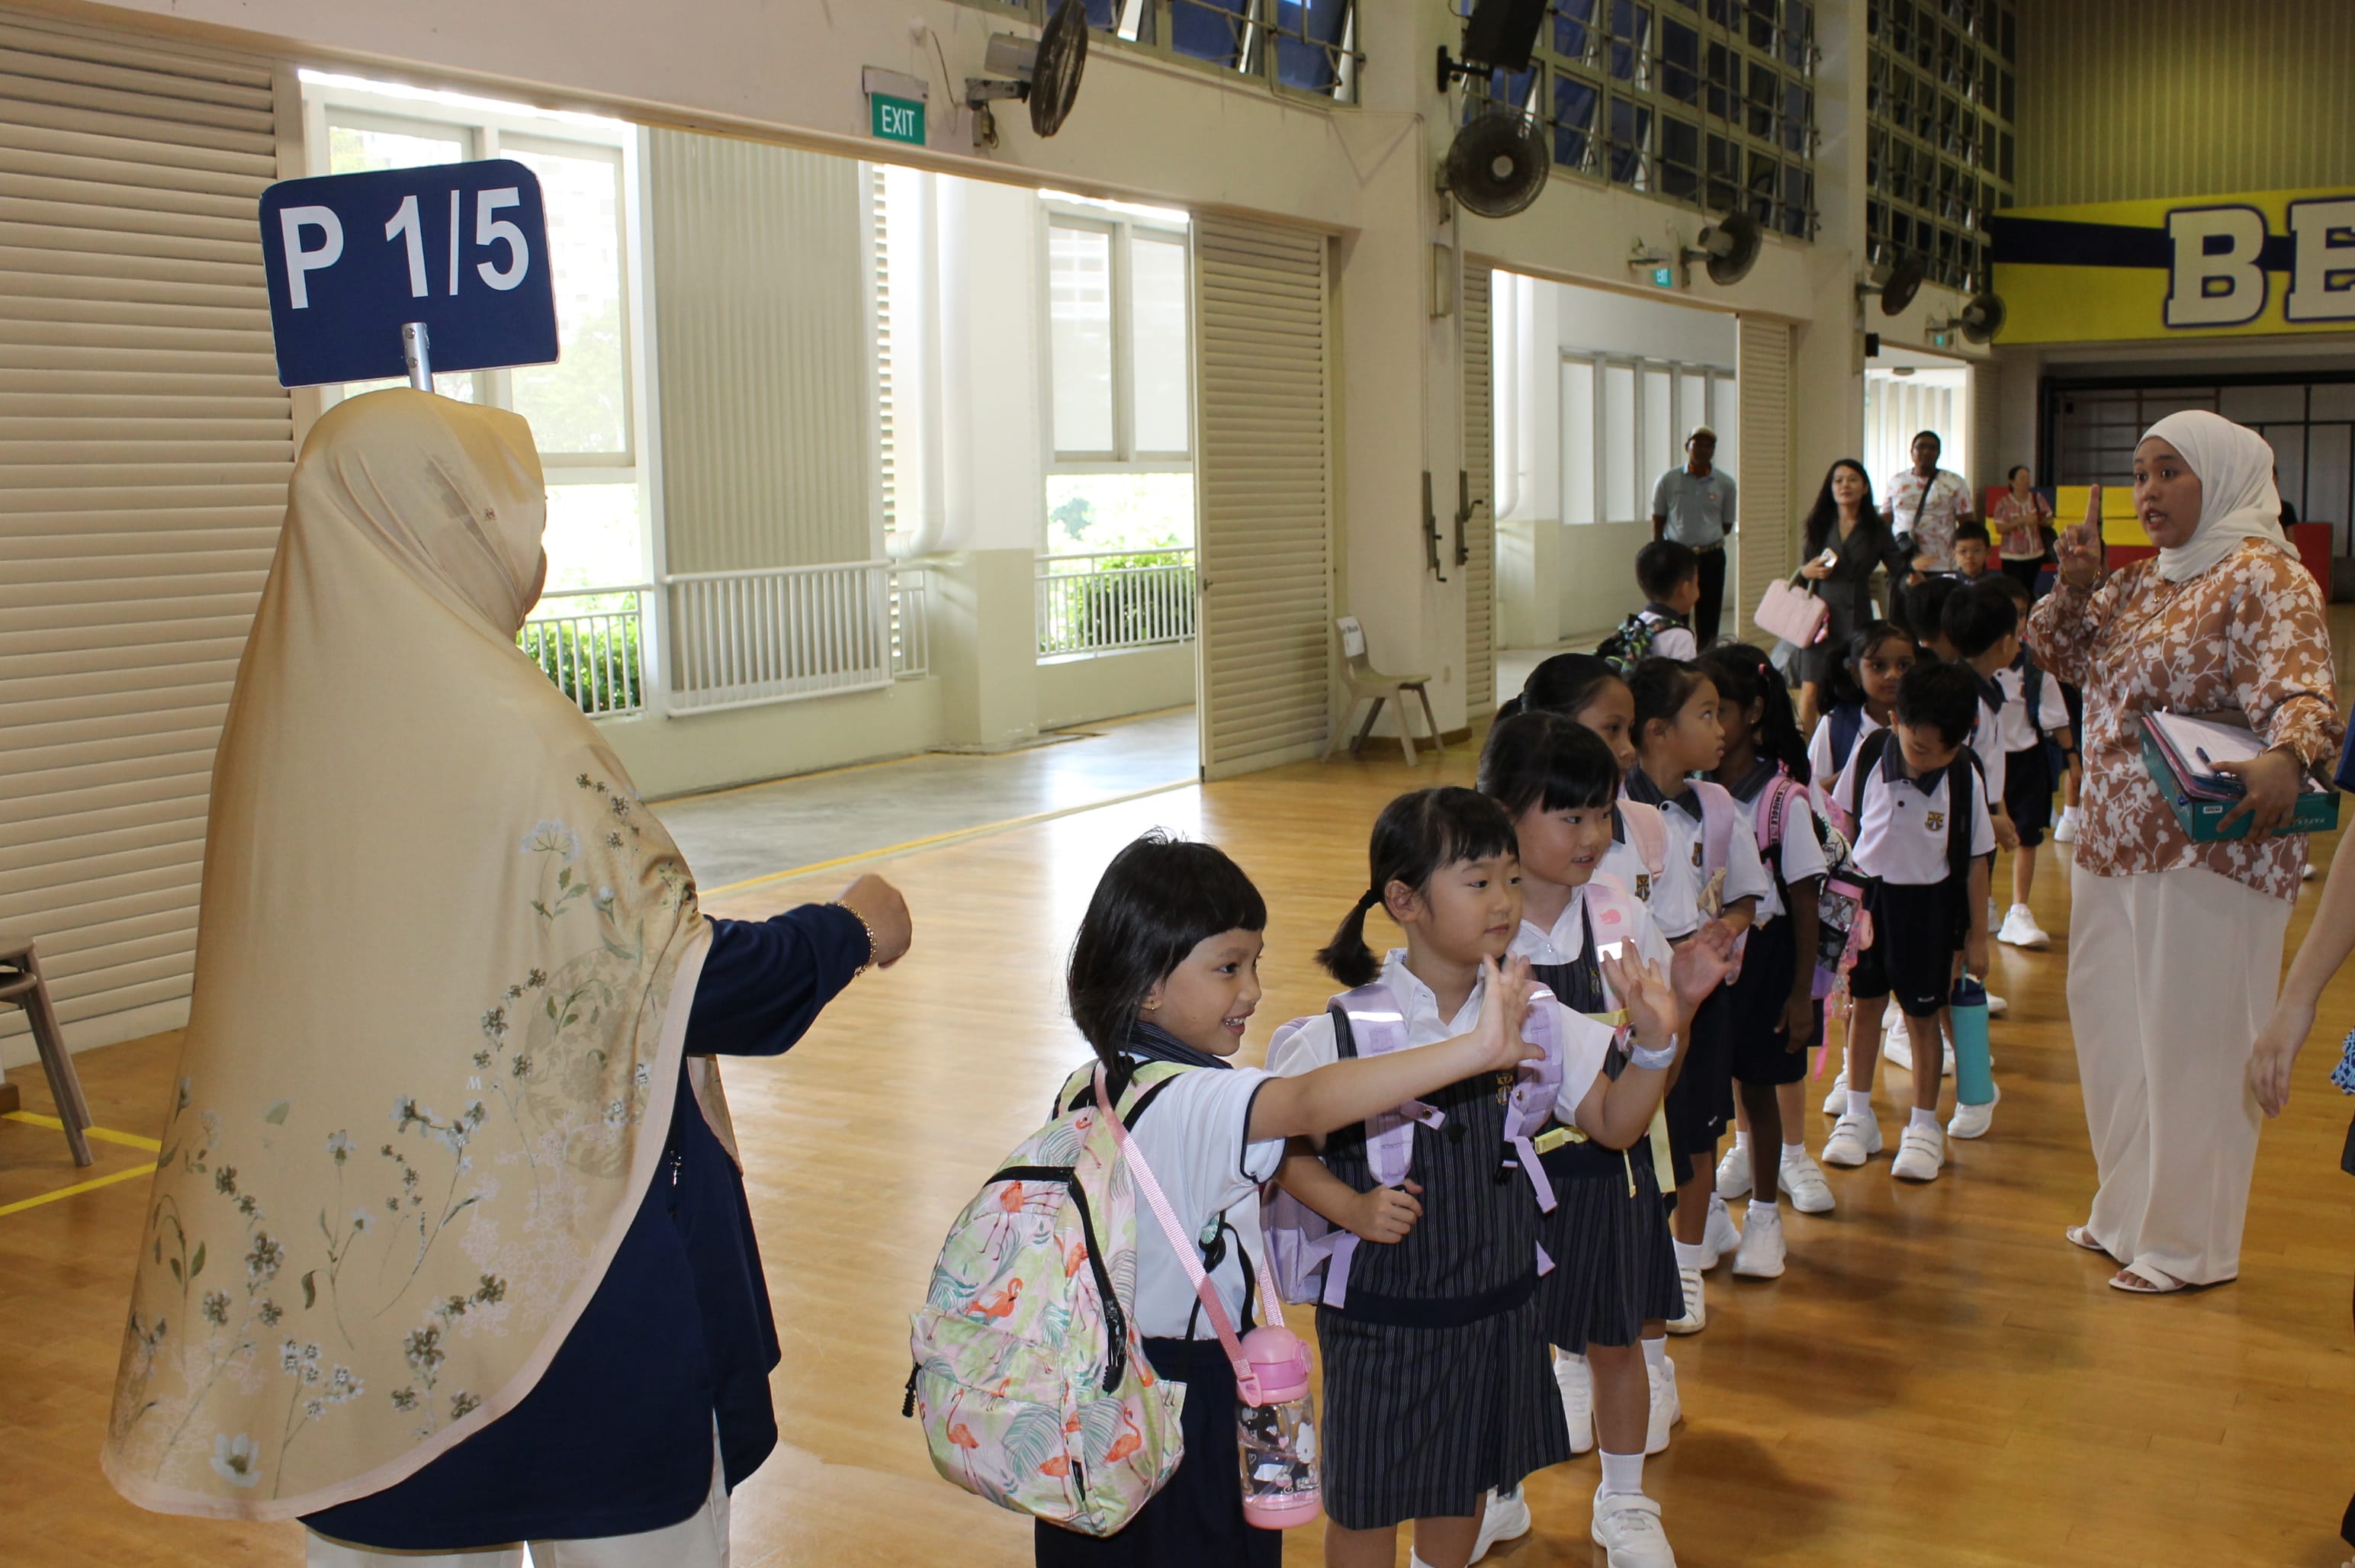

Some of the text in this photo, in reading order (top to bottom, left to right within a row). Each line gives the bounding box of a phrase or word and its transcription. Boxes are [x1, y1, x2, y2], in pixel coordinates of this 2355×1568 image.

[882, 104, 915, 137] EXIT
[280, 187, 530, 310] P 1/5
